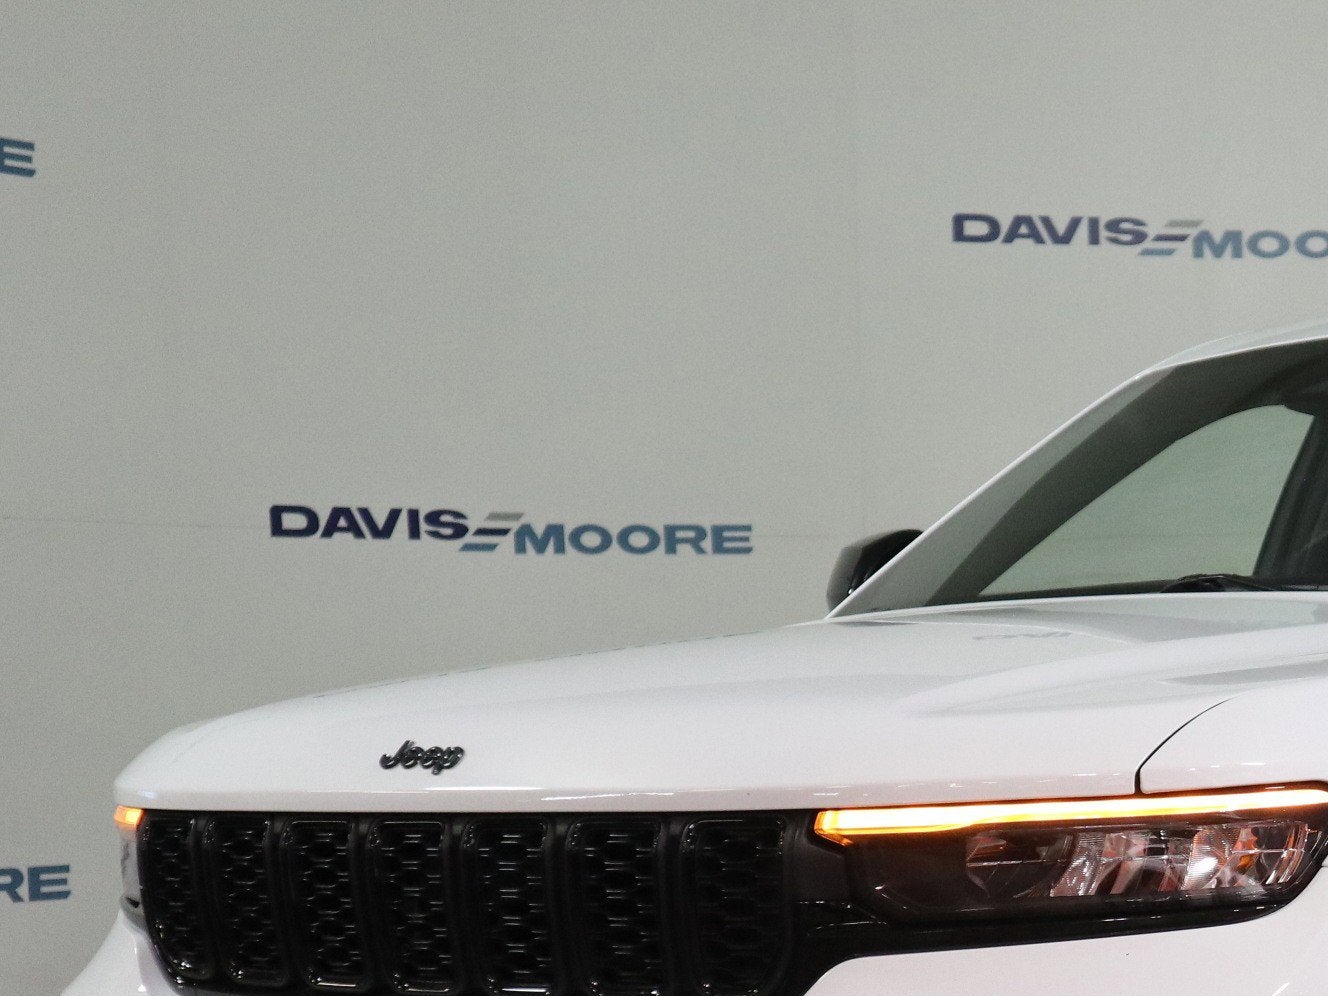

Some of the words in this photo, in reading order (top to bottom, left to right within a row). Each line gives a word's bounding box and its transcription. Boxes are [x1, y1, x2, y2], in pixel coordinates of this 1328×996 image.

[950, 212, 1148, 246] DAVIS
[268, 504, 470, 540] DAVIS
[513, 522, 754, 555] MOORE
[379, 739, 465, 776] Jeep
